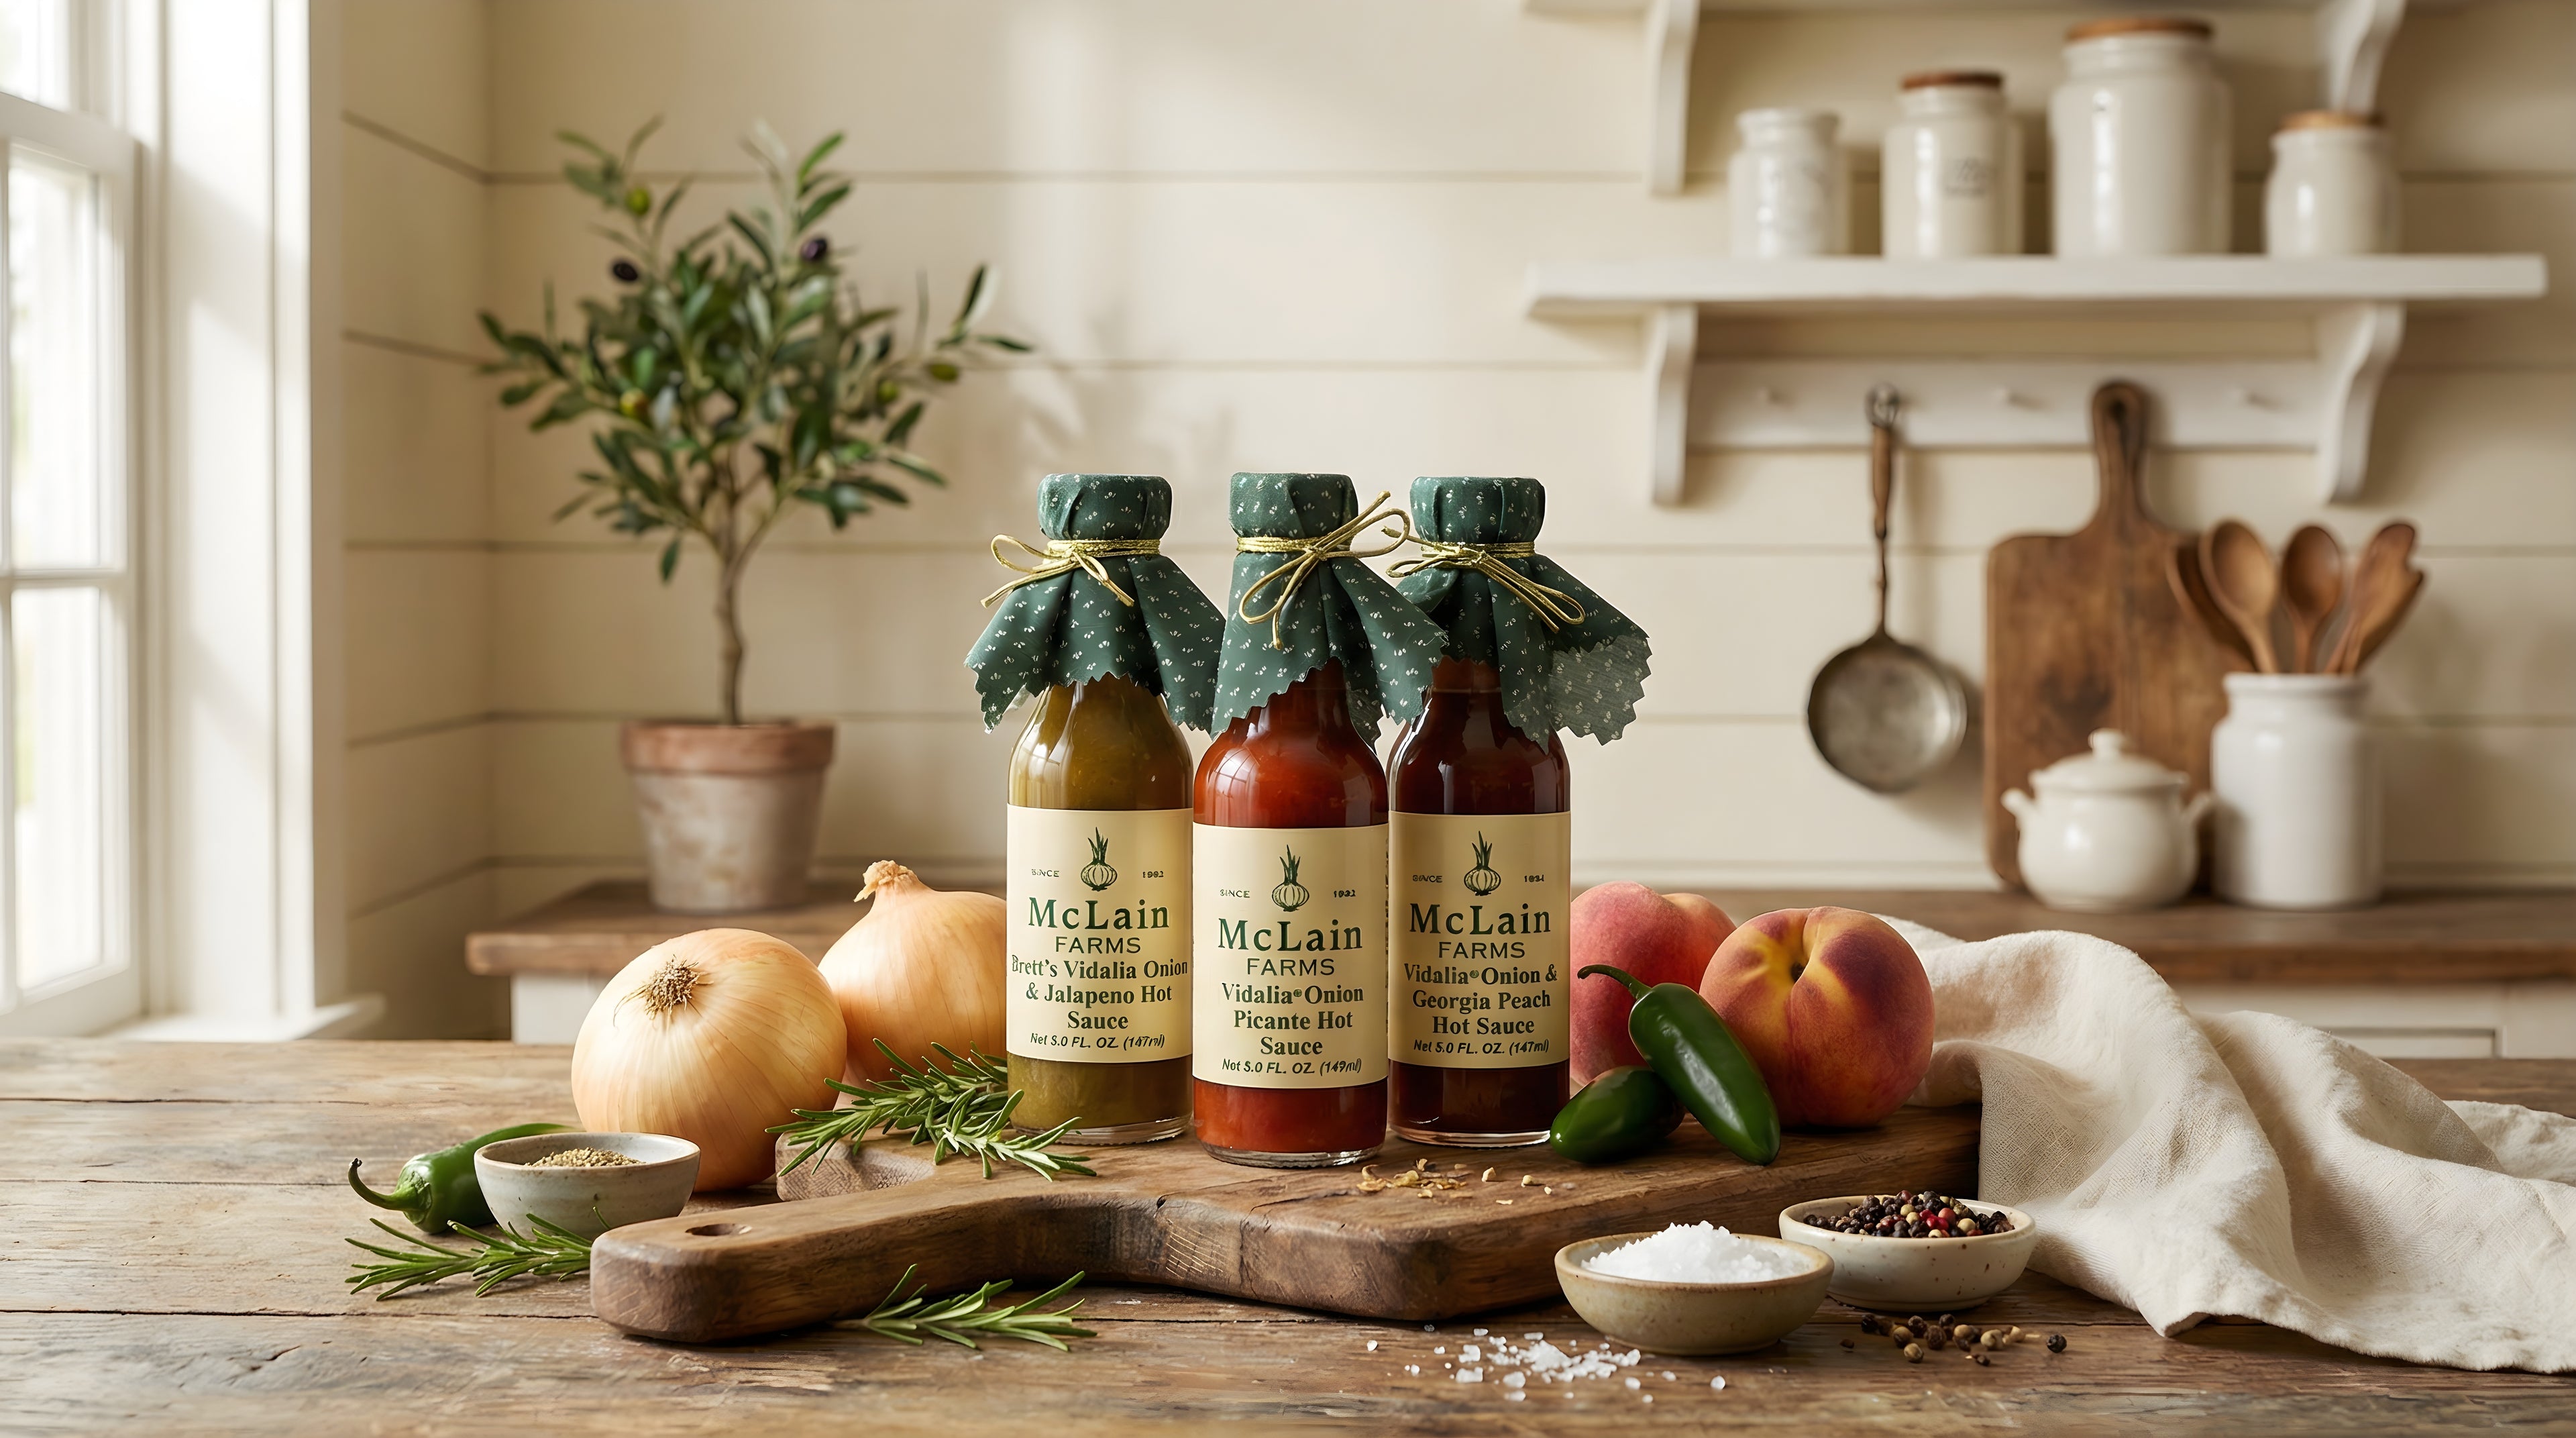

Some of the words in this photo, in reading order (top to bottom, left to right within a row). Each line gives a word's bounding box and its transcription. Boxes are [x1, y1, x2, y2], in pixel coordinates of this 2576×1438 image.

[1028, 897, 1170, 930] McLain
[1408, 903, 1550, 934] McLain
[1056, 935, 1141, 954] FARMS
[1218, 917, 1362, 952] McLain
[1439, 941, 1525, 959] FARMS
[1065, 959, 1137, 980] Vidalia
[1143, 957, 1189, 978] Onion
[1247, 958, 1334, 976] FARMS
[1481, 966, 1541, 985] Onion
[1545, 964, 1558, 982] &
[1026, 982, 1038, 1000] &
[1044, 983, 1135, 1009] Jalapeno
[1140, 983, 1173, 1003] Hot
[1305, 985, 1363, 1004] Onion
[1411, 988, 1491, 1015] Georgia
[1498, 990, 1552, 1009] Peach
[1068, 1009, 1128, 1029] Sauce
[1234, 1009, 1310, 1030] Picante
[1318, 1011, 1352, 1029] Hot
[1433, 1016, 1470, 1035] Hot
[1476, 1016, 1534, 1036] Sauce
[1260, 1036, 1323, 1056] Sauce
[1457, 1041, 1478, 1054] FL.
